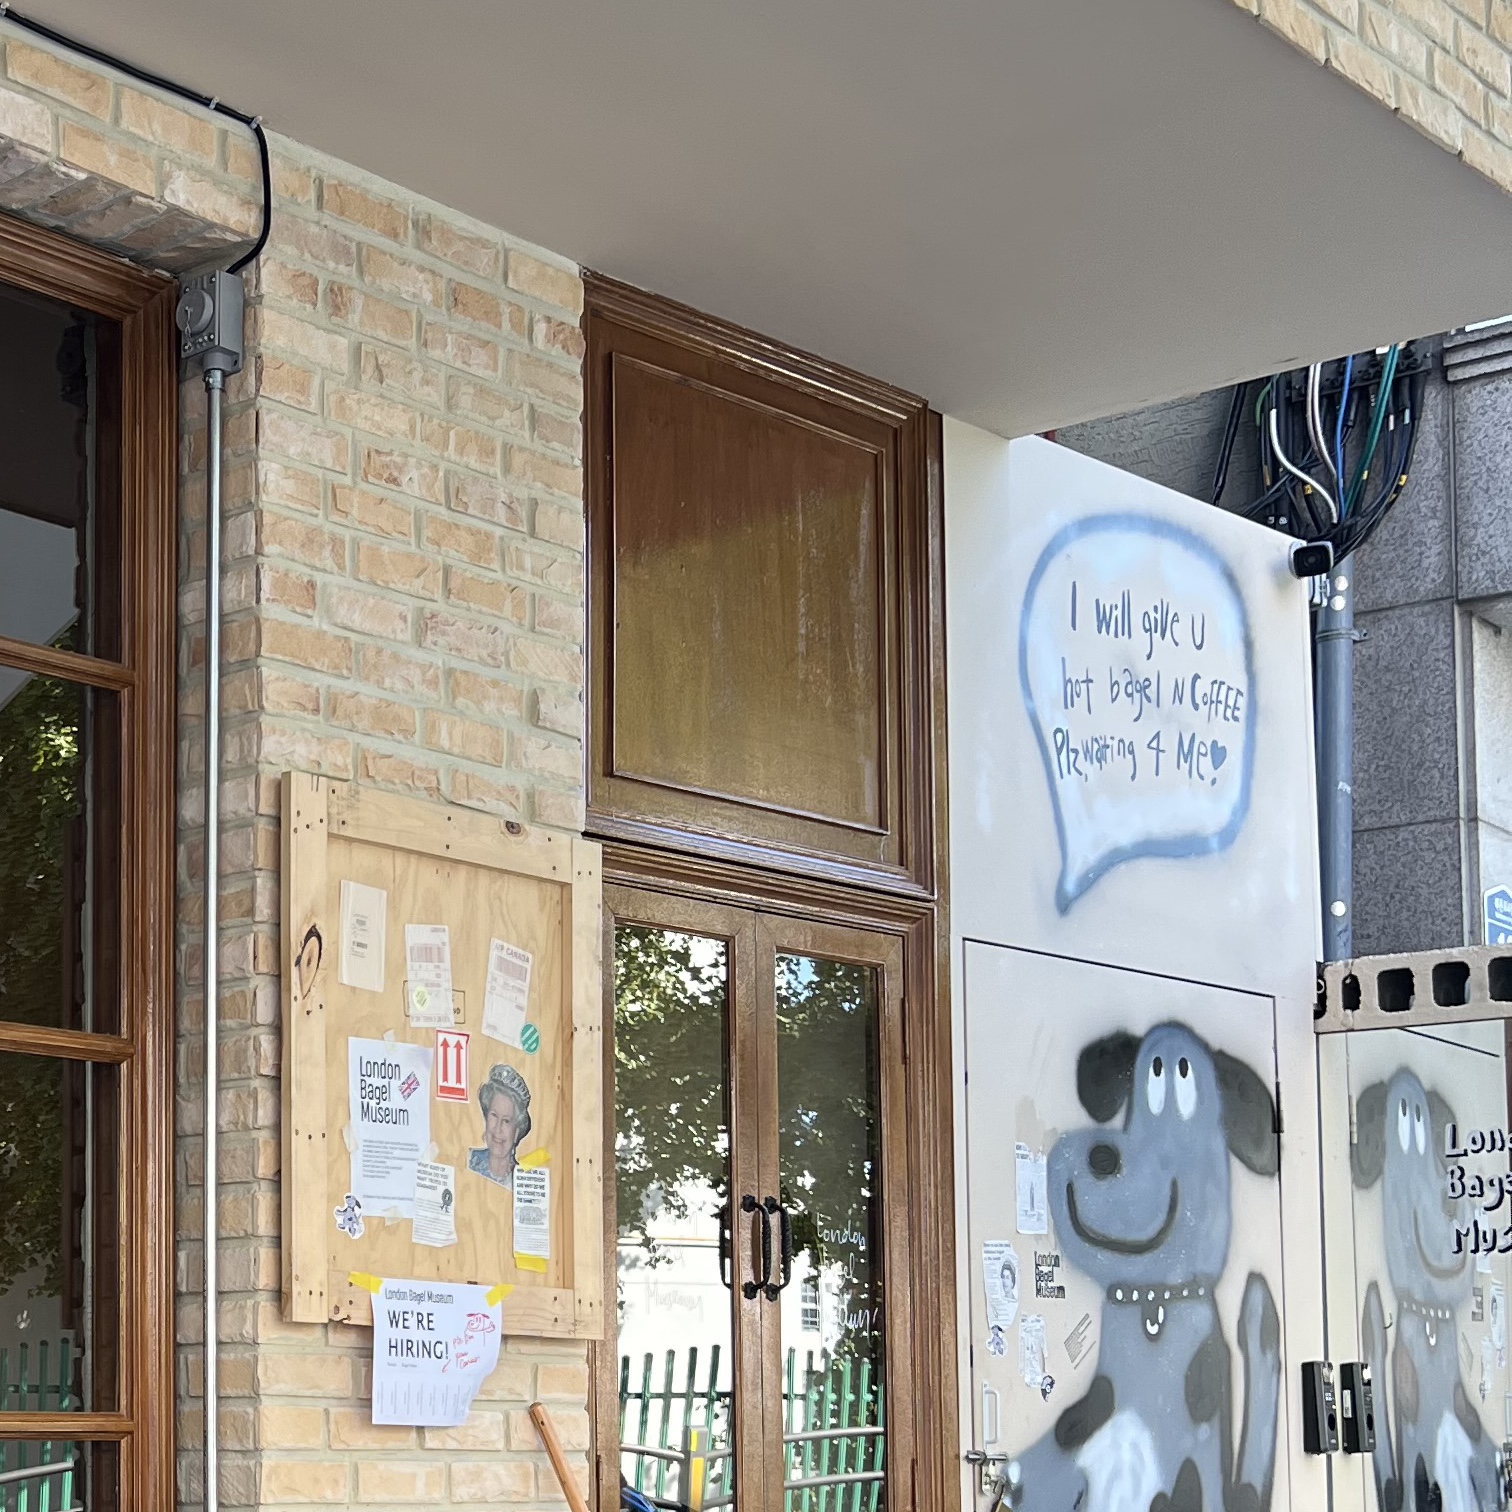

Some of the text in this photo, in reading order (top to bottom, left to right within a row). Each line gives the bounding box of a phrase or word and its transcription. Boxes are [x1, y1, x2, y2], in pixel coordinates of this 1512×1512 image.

[1071, 580, 1077, 631] I
[1062, 656, 1094, 715] hot
[1110, 665, 1161, 723] bagel
[1147, 730, 1166, 777] 4
[359, 1055, 402, 1082] London
[360, 1078, 391, 1105] Bagel
[360, 1100, 410, 1127] Museum
[1034, 1250, 1060, 1268] London
[384, 1287, 454, 1305] London Bagel Museum
[1035, 1279, 1066, 1299] Museum
[387, 1309, 436, 1331] WE'RE
[388, 1337, 449, 1360] HIRING!
